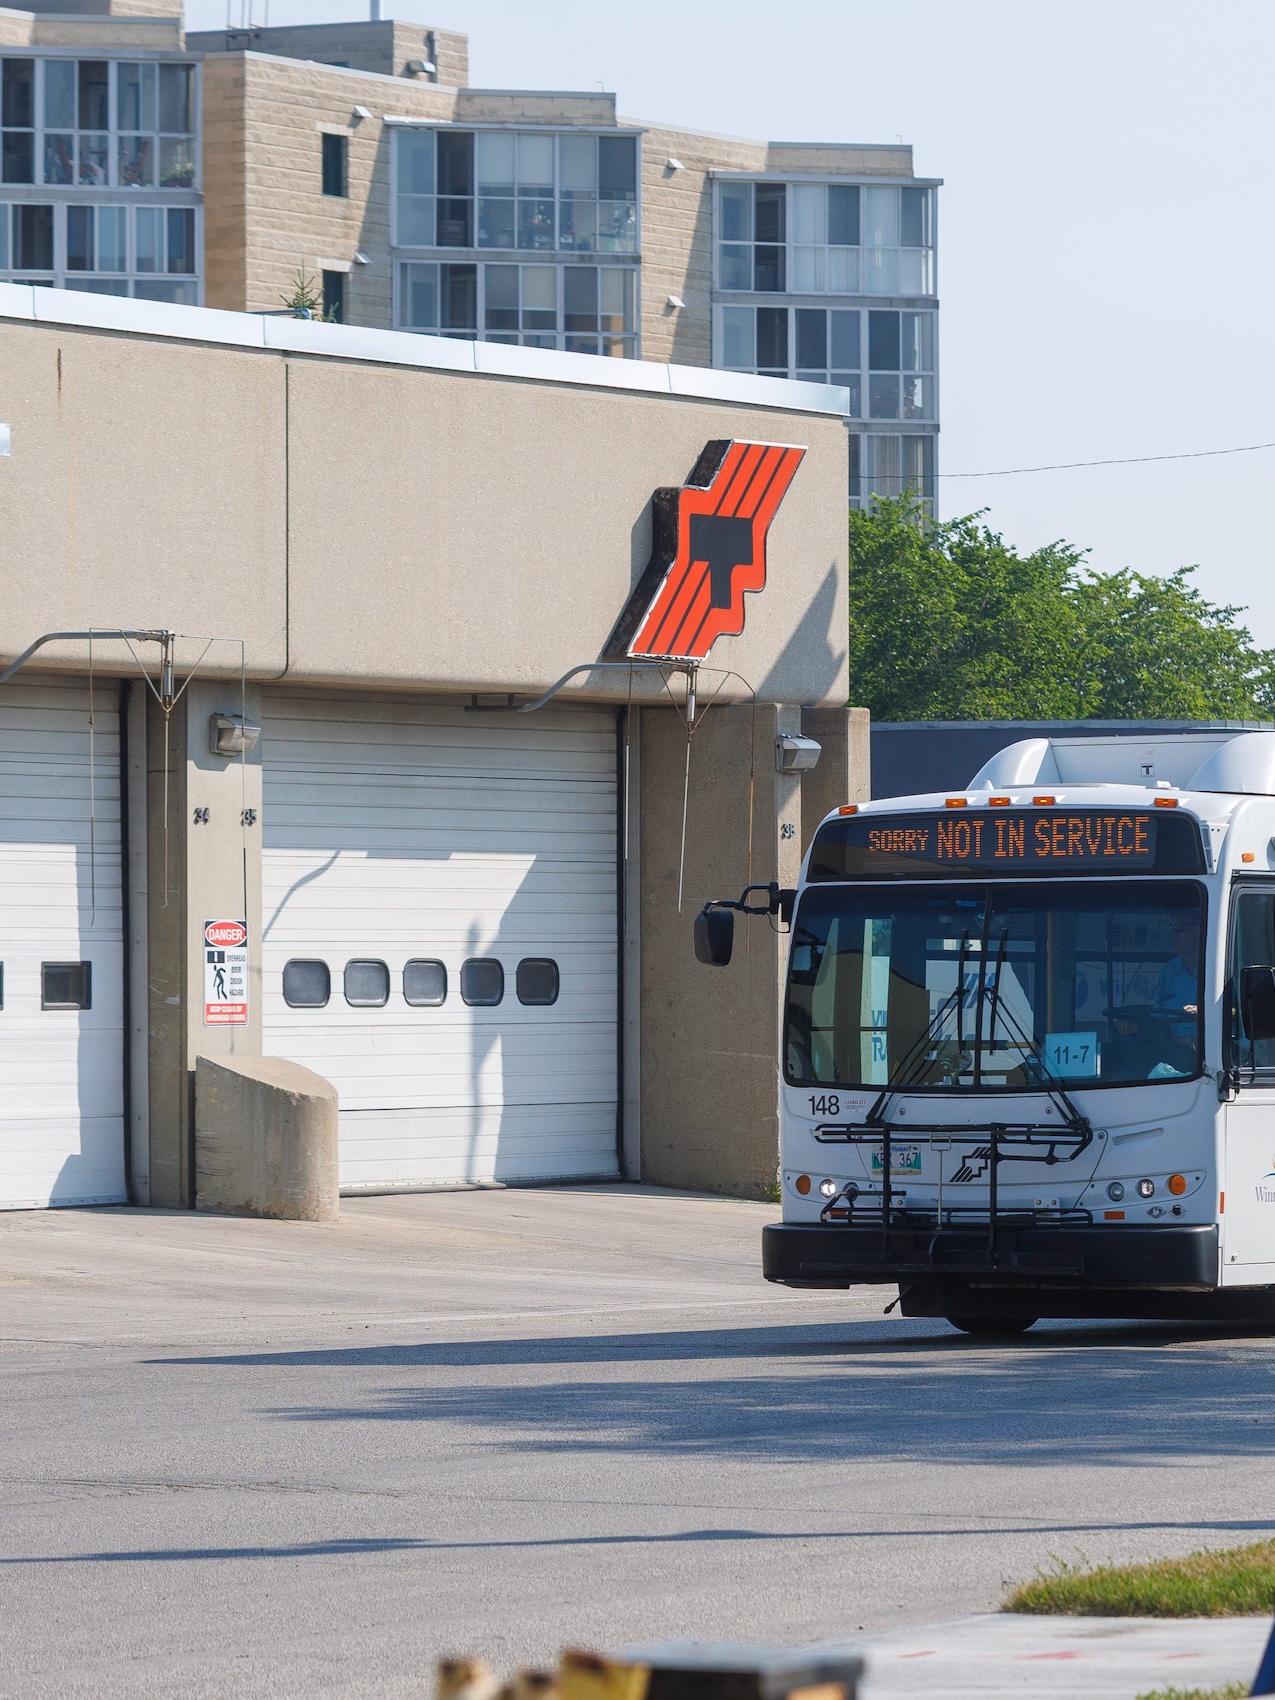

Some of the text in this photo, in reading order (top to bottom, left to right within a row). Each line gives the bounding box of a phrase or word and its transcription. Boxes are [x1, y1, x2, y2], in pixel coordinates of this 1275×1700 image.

[868, 816, 1150, 858] SORRY NOT IN SERVICE
[208, 928, 243, 941] DANGER
[1053, 1044, 1090, 1066] 11-7
[808, 1095, 840, 1116] 148
[899, 1151, 918, 1167] 367
